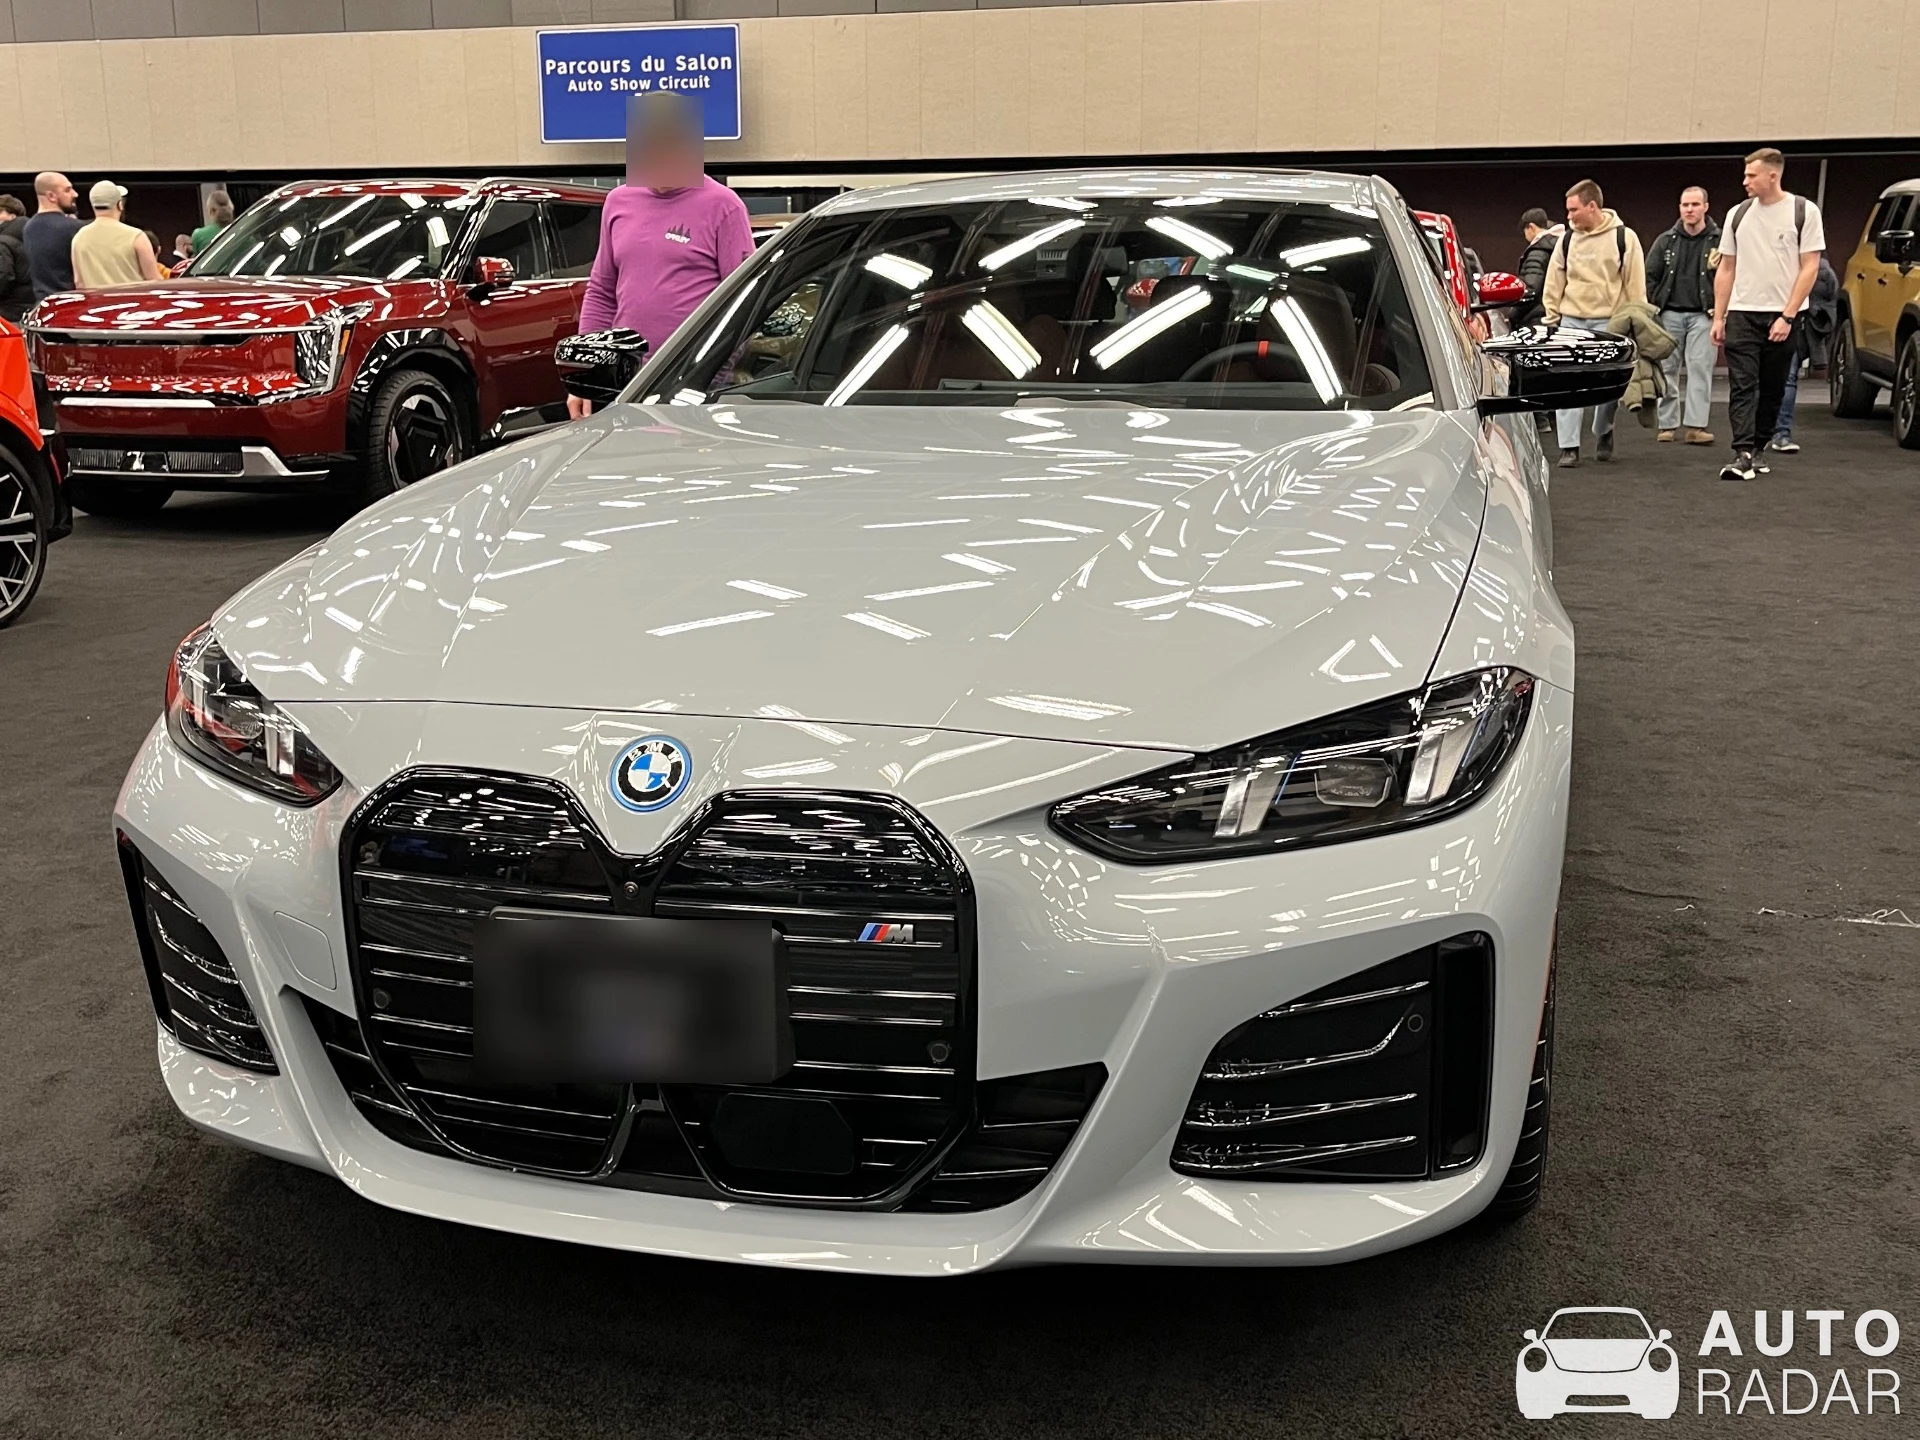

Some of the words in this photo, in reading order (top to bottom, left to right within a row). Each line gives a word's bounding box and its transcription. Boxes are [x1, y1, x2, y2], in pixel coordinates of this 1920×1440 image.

[545, 59, 631, 76] Parcours
[641, 56, 665, 73] du
[675, 54, 732, 72] Salon
[567, 79, 603, 92] Auto
[610, 78, 651, 91] Show
[658, 75, 711, 90] Circuit
[627, 742, 681, 763] BMW
